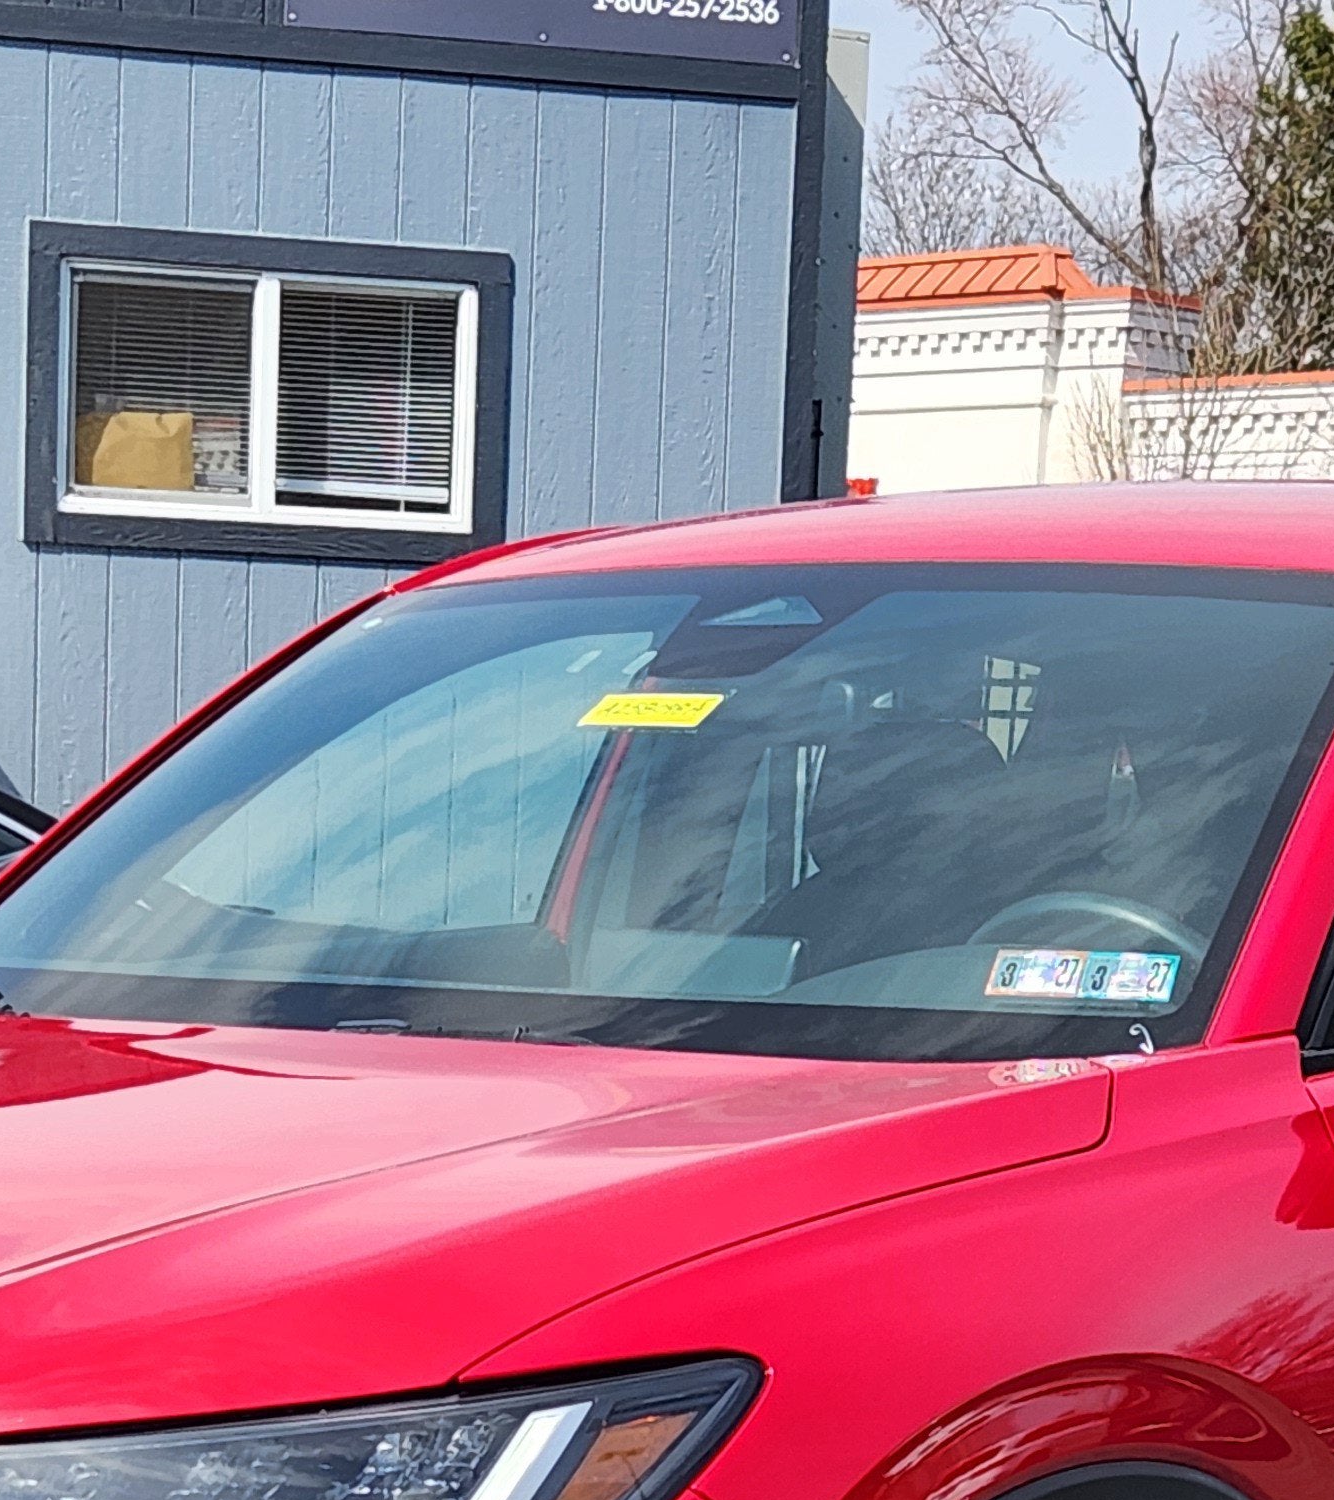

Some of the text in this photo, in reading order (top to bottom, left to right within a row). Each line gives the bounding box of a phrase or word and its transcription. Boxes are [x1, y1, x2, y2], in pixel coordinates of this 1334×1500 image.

[1000, 958, 1080, 988] 3 27
[1091, 962, 1173, 992] 3 27
